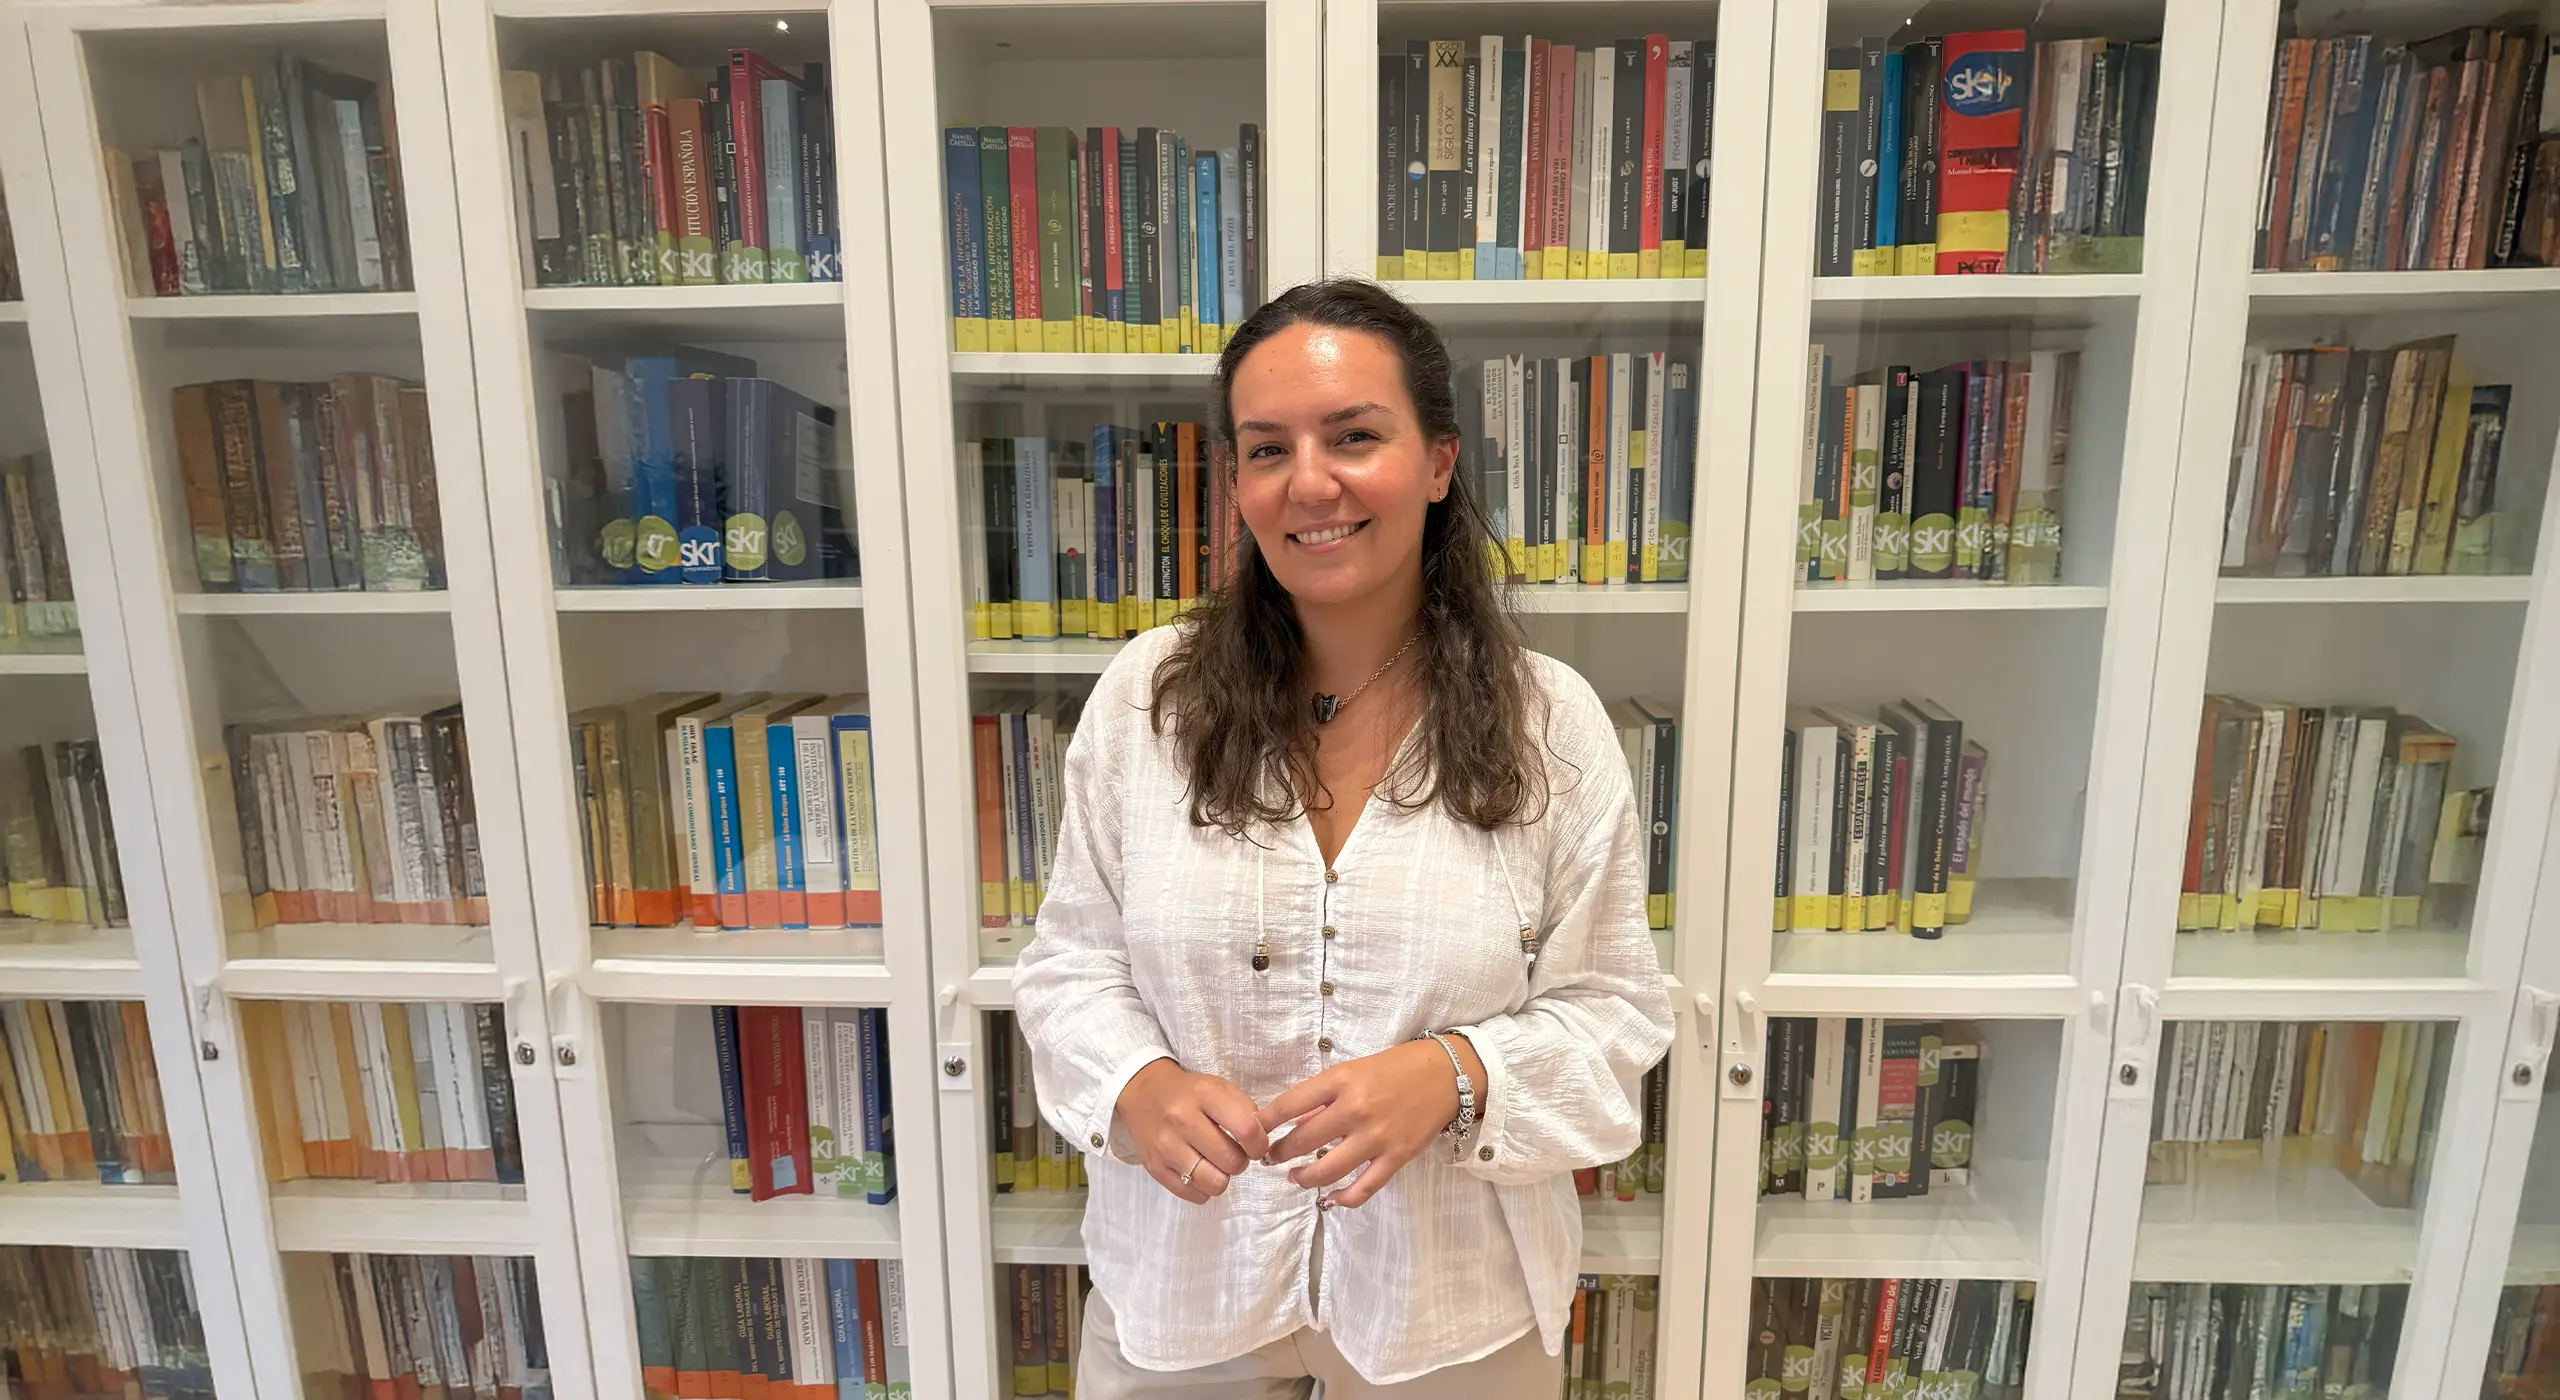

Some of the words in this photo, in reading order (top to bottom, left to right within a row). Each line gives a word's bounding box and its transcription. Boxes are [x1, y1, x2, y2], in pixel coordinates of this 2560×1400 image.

[1533, 53, 1543, 87] ESPAÑA
[1465, 64, 1476, 117] fracasadas
[1675, 80, 1683, 92] XX
[1436, 91, 1444, 127] olvidado
[1444, 105, 1455, 120] XX
[1532, 89, 1541, 120] SOBRE
[1674, 92, 1683, 118] SIGLO
[1437, 127, 1443, 136] el
[1673, 119, 1681, 129] EL
[949, 138, 976, 148] CASTELLS
[951, 133, 973, 141] MANUEL
[980, 142, 1007, 151] CASTELLS
[1008, 140, 1034, 149] CASTELLS
[1444, 123, 1454, 160] SIGLO
[1465, 118, 1474, 157] culturas
[1532, 121, 1541, 161] INFORME
[1672, 130, 1681, 161] PENSAR
[1465, 159, 1474, 174] Las
[1107, 163, 1115, 213] ANTIAMERICANA
[1553, 176, 1559, 184] EL
[1559, 172, 1567, 202] CAMBIOS
[1463, 186, 1474, 219] Marina
[1551, 207, 1557, 217] LA
[1552, 197, 1558, 206] DE
[1559, 204, 1565, 213] DE
[1671, 194, 1679, 212] TONY
[954, 192, 964, 261] INFORMACIÓN
[1001, 206, 1009, 246] IDENTIDAD
[1012, 193, 1021, 263] INFORMACIÓN
[1559, 214, 1565, 222] LA
[986, 195, 996, 265] INFORMACIÓN
[1109, 215, 1117, 246] OBSESIÓN
[1226, 217, 1235, 242] PUZZLE
[1002, 248, 1008, 258] LA
[1110, 247, 1117, 255] LA
[1227, 244, 1235, 258] DEL
[957, 265, 965, 278] LA
[989, 268, 996, 280] LA
[1003, 261, 1009, 270] DE
[1014, 266, 1021, 278] LA
[958, 280, 966, 293] DE
[990, 284, 997, 297] DE
[1015, 282, 1022, 294] DE
[1004, 301, 1010, 310] EL
[1892, 419, 1900, 427] de
[1939, 408, 1947, 429] Europa
[1891, 428, 1900, 452] trampa
[1890, 453, 1898, 464] La
[1158, 459, 1169, 508] CIVILIZACIONES
[1159, 508, 1170, 518] DE
[726, 526, 766, 554] skr
[1159, 518, 1171, 545] CHOQUE
[1912, 526, 1955, 554] skr
[681, 539, 721, 567] skr
[1160, 545, 1171, 553] EL
[1161, 556, 1172, 597] HUNTINGTON
[681, 725, 690, 755] MANUAL
[689, 725, 698, 740] GUY
[690, 742, 699, 763] ISAAC
[802, 743, 809, 754] DE
[1884, 741, 1893, 772] expertos
[1942, 735, 1952, 778] inmigración
[683, 757, 690, 766] DE
[803, 754, 810, 765] LA
[810, 743, 820, 797] INSTITUCIONES
[684, 768, 694, 800] DERECHO
[804, 766, 813, 789] UNIÓN
[846, 762, 855, 793] EUROPEA
[1882, 774, 1890, 784] los
[1941, 780, 1949, 788] la
[1960, 768, 1976, 801] mundo
[1882, 785, 1890, 793] de
[805, 790, 815, 823] EUROPEA
[847, 794, 856, 817] UNIÓN
[1881, 795, 1889, 825] mundial
[1936, 791, 1949, 835] Comprender
[1957, 803, 1969, 818] del
[687, 802, 698, 850] COMUNITARIO
[814, 804, 823, 838] DERECHO
[850, 817, 857, 827] LA
[851, 829, 858, 837] DE
[1038, 812, 1048, 866] EMPRENDEDORES
[1879, 825, 1888, 857] gobierno
[1954, 820, 1966, 852] estado
[852, 838, 860, 872] POLÍTICAS
[1934, 838, 1943, 862] Dehesa
[1952, 853, 1963, 863] El
[691, 852, 700, 883] GENERAL
[1878, 857, 1885, 866] El
[1044, 871, 1050, 880] DE
[1933, 872, 1939, 881] de
[1782, 1051, 1791, 1062] del
[1781, 1063, 1791, 1091] Estudios
[1779, 1102, 1788, 1122] Pardo
[1877, 1134, 1913, 1159] skr
[1932, 1131, 1972, 1154] skr
[1019, 1269, 1030, 1297] mundo
[1031, 1280, 1041, 1303] 2010
[1885, 1285, 1897, 1297] de
[1899, 1284, 1908, 1296] del
[734, 1282, 744, 1318] LABORAL
[762, 1284, 772, 1321] LABORAL
[834, 1288, 845, 1323] LABORAL
[1020, 1299, 1030, 1311] del
[1896, 1296, 1906, 1313] estilo
[1920, 1288, 1936, 1324] capitalismo
[1020, 1313, 1031, 1339] estado
[1881, 1299, 1896, 1332] camino
[738, 1320, 747, 1337] GUÍA
[765, 1321, 774, 1340] GUÍA
[838, 1324, 847, 1343] GUÍA
[1878, 1334, 1888, 1344] EL
[1890, 1329, 1901, 1348] Verdú
[1919, 1326, 1927, 1334] El
[1021, 1340, 1031, 1349] El
[1914, 1341, 1924, 1361] Verdú
[1873, 1348, 1884, 1377] LEGUINA
